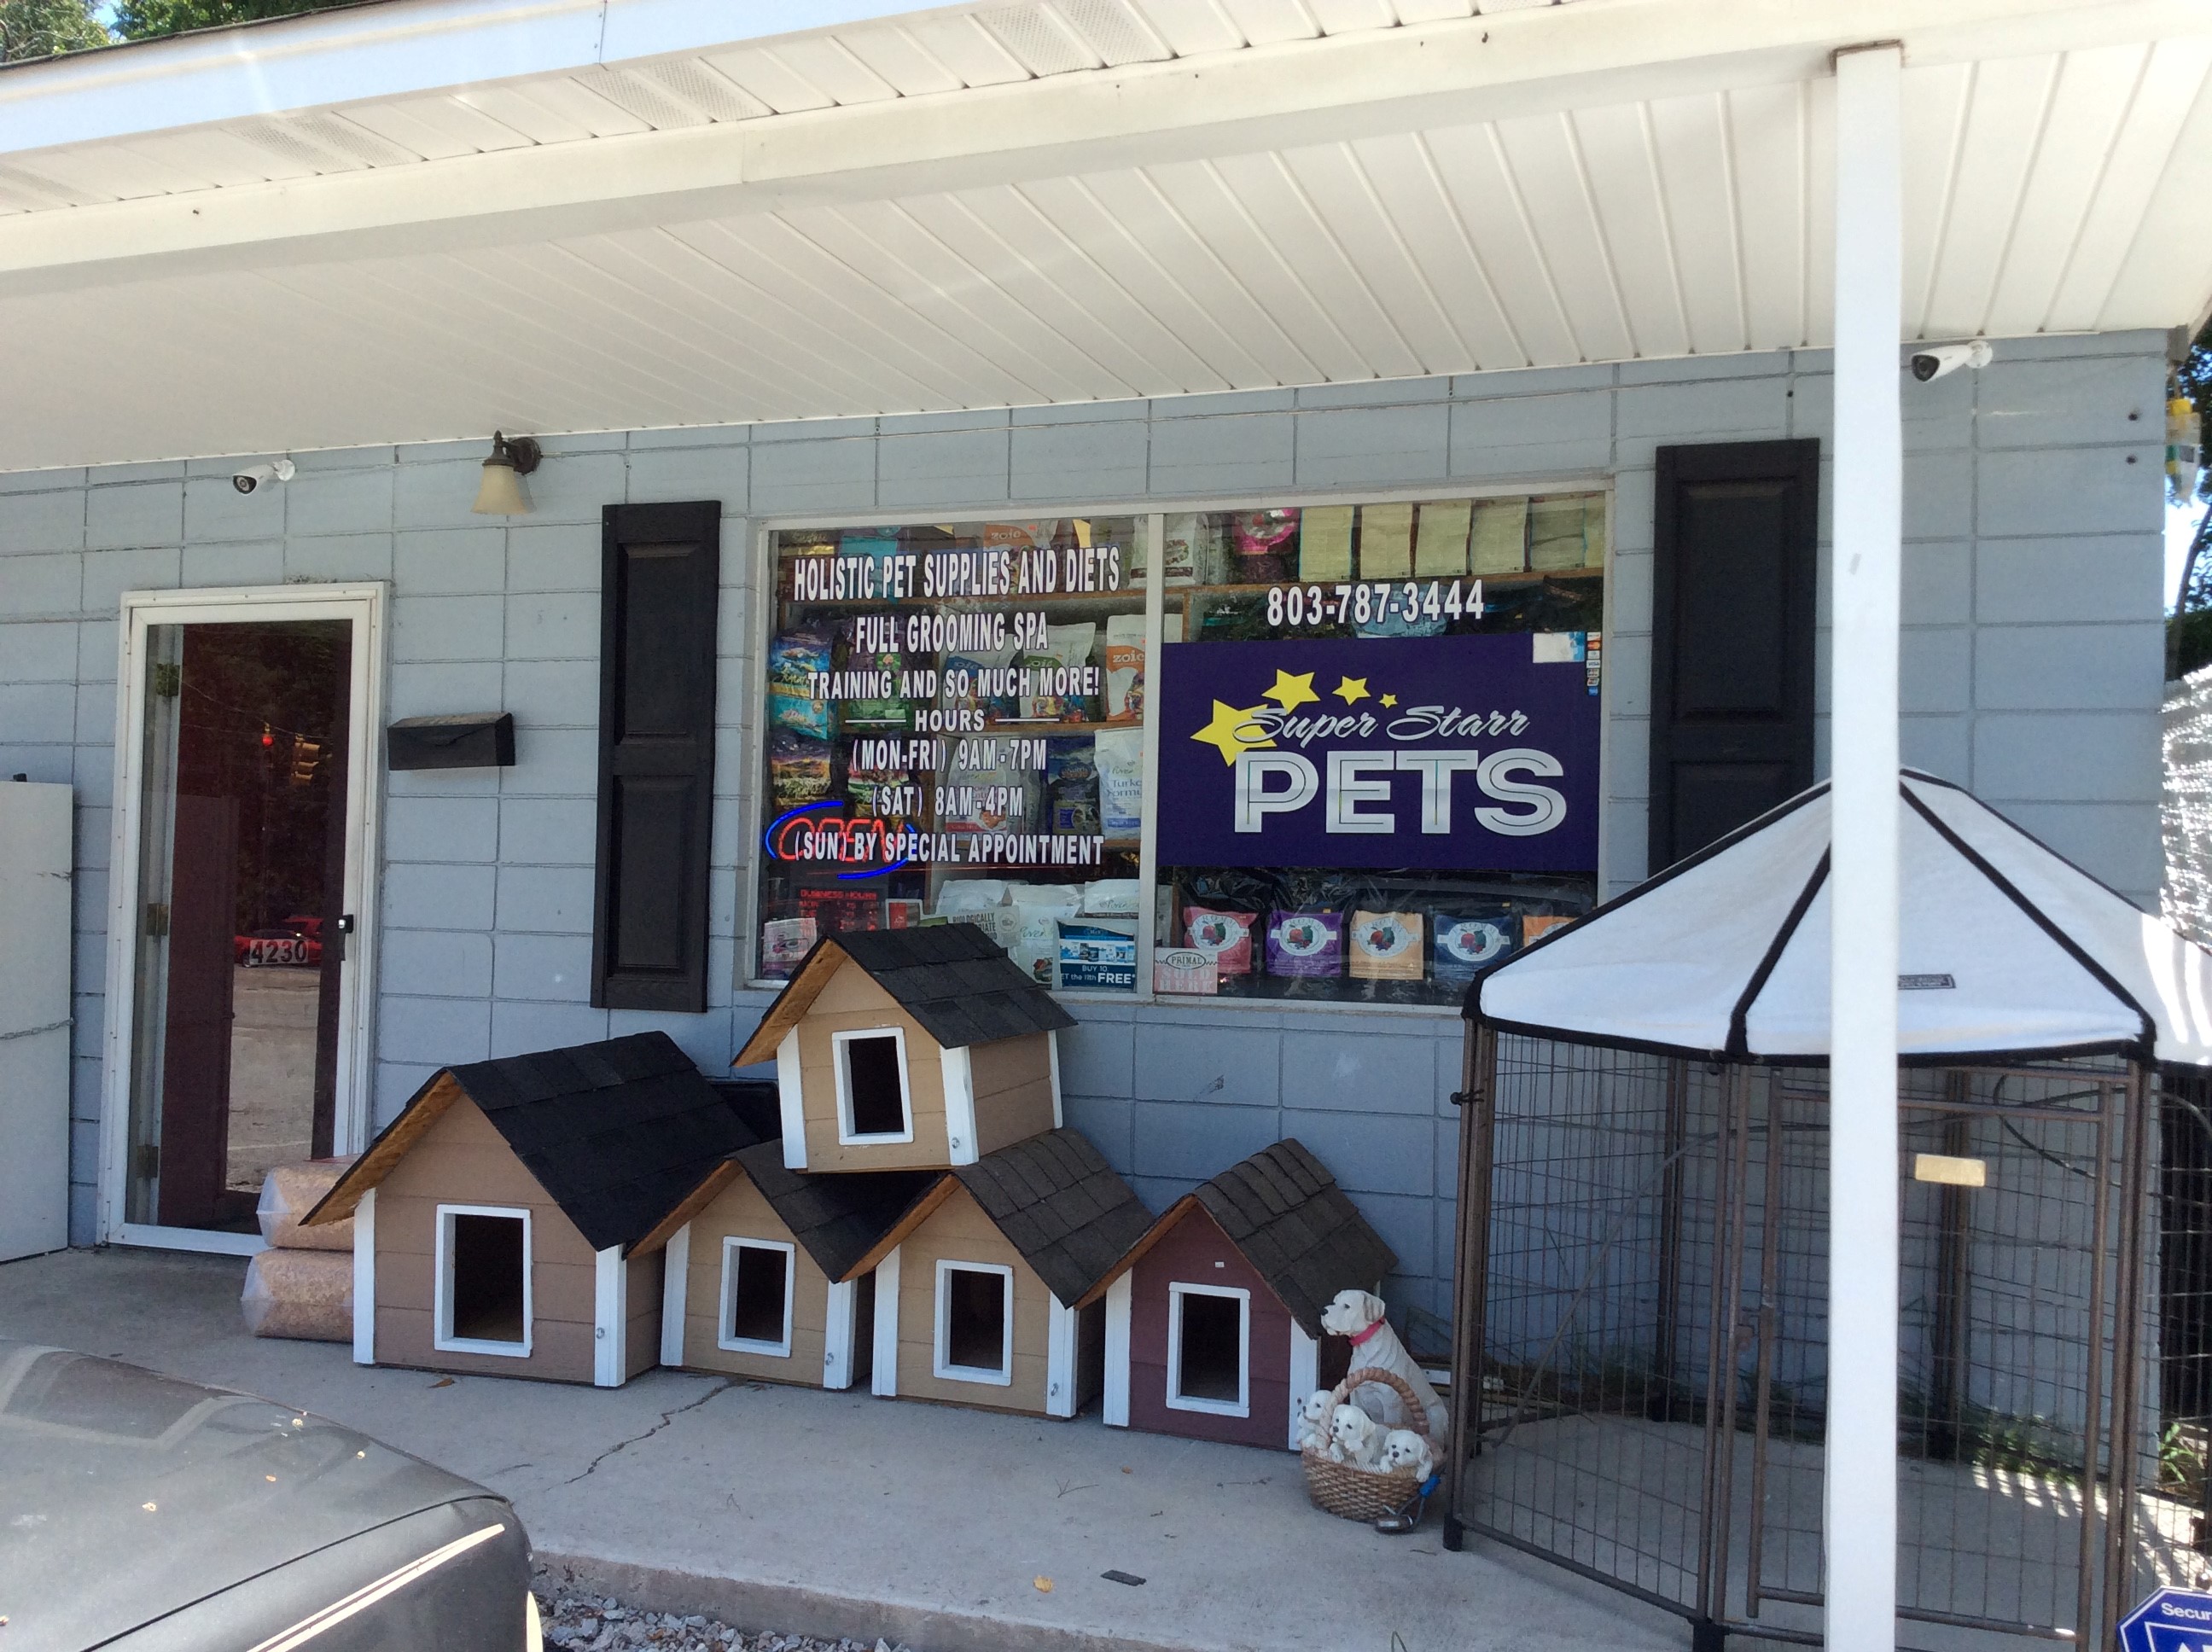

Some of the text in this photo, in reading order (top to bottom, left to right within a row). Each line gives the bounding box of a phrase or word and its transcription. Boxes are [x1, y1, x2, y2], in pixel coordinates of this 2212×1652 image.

[794, 546, 1121, 601] HOLISTIC PET SUPPLIES AND DIETS
[1266, 579, 1484, 626] 803-787-3444
[856, 611, 1049, 654] FULL GROOMING SPA
[807, 666, 1099, 700] TRAINING AND SO MUCH MORE!
[914, 709, 986, 732] HOURS
[1232, 705, 1530, 749] Super Starr
[853, 740, 946, 773] (MON-FRI)
[872, 786, 923, 817] (SAT)
[1234, 748, 1567, 836] PETS
[795, 831, 1104, 865] (SUN) BY SPECIAL APPOINTMENT
[251, 940, 307, 963] 4230
[1172, 956, 1202, 965] PRIMAL
